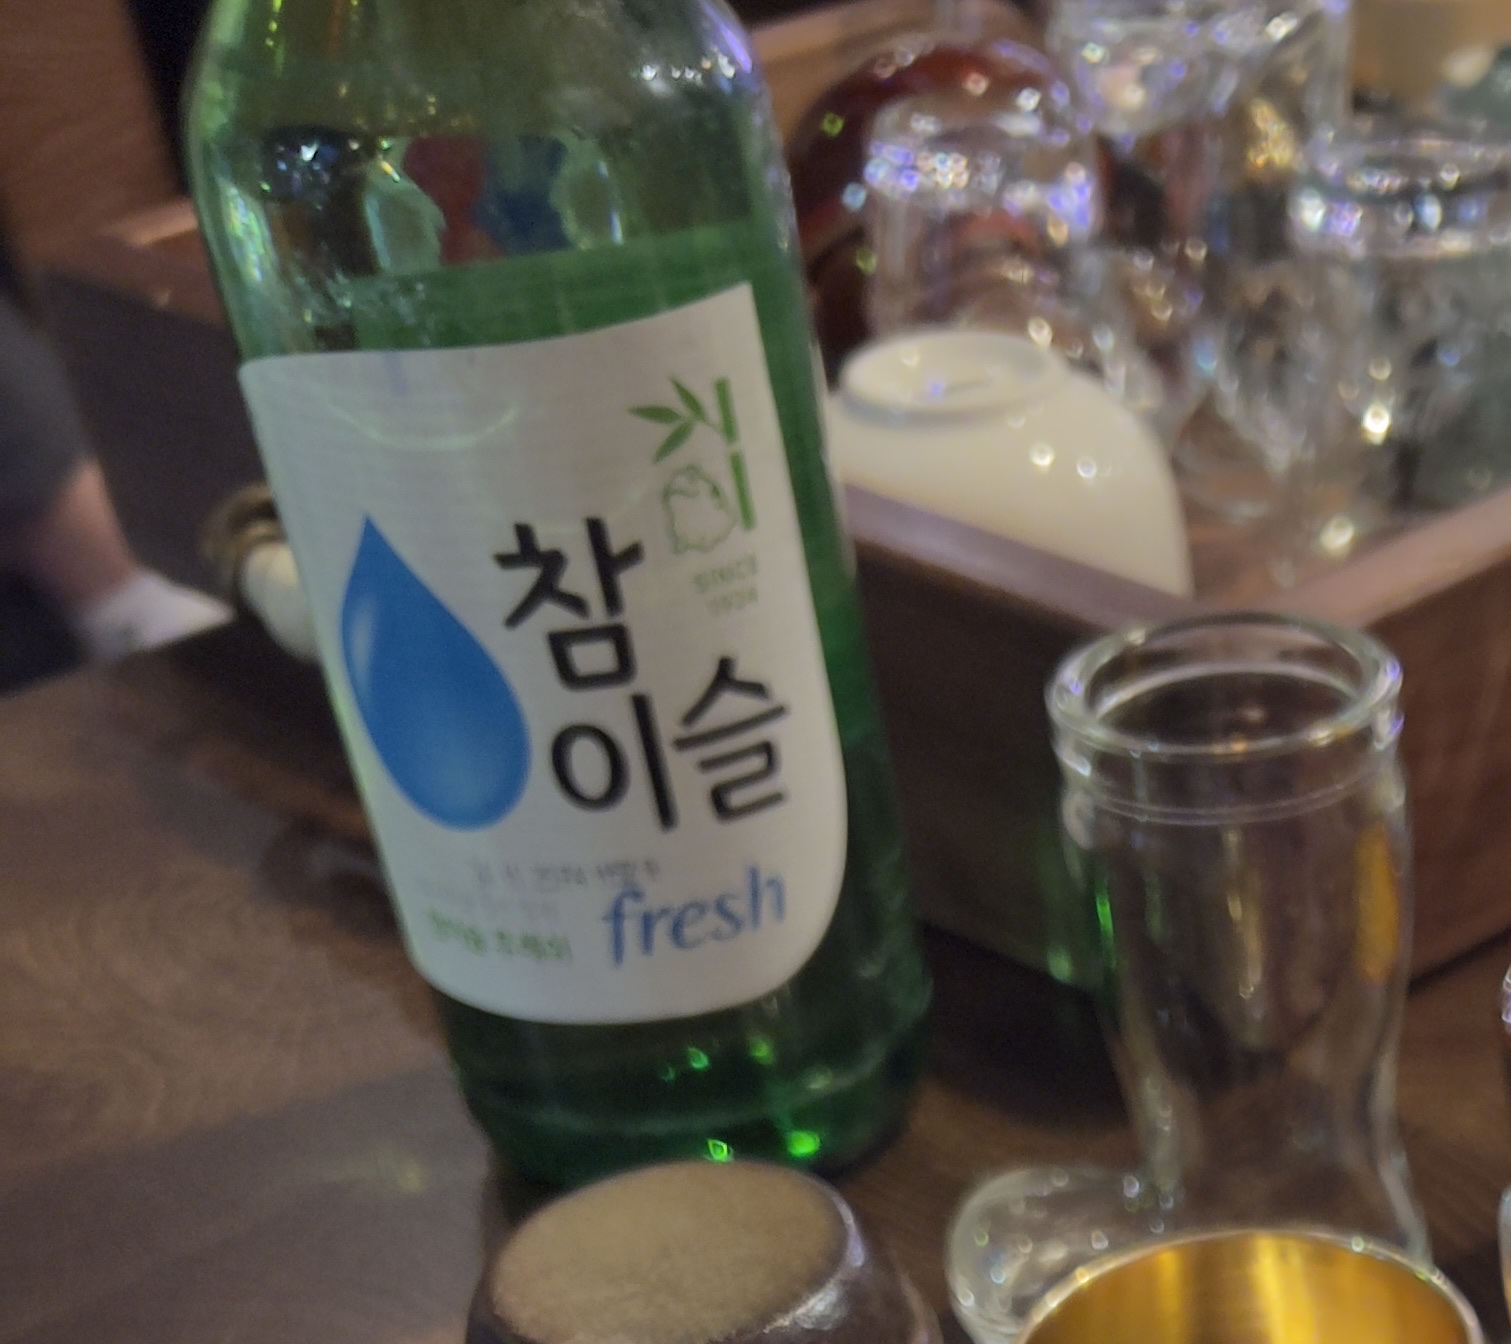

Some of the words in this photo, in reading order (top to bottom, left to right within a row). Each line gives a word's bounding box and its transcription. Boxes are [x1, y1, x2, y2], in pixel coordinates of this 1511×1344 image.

[494, 516, 645, 694] 참
[550, 655, 791, 833] 이슬
[602, 865, 787, 970] fresh
